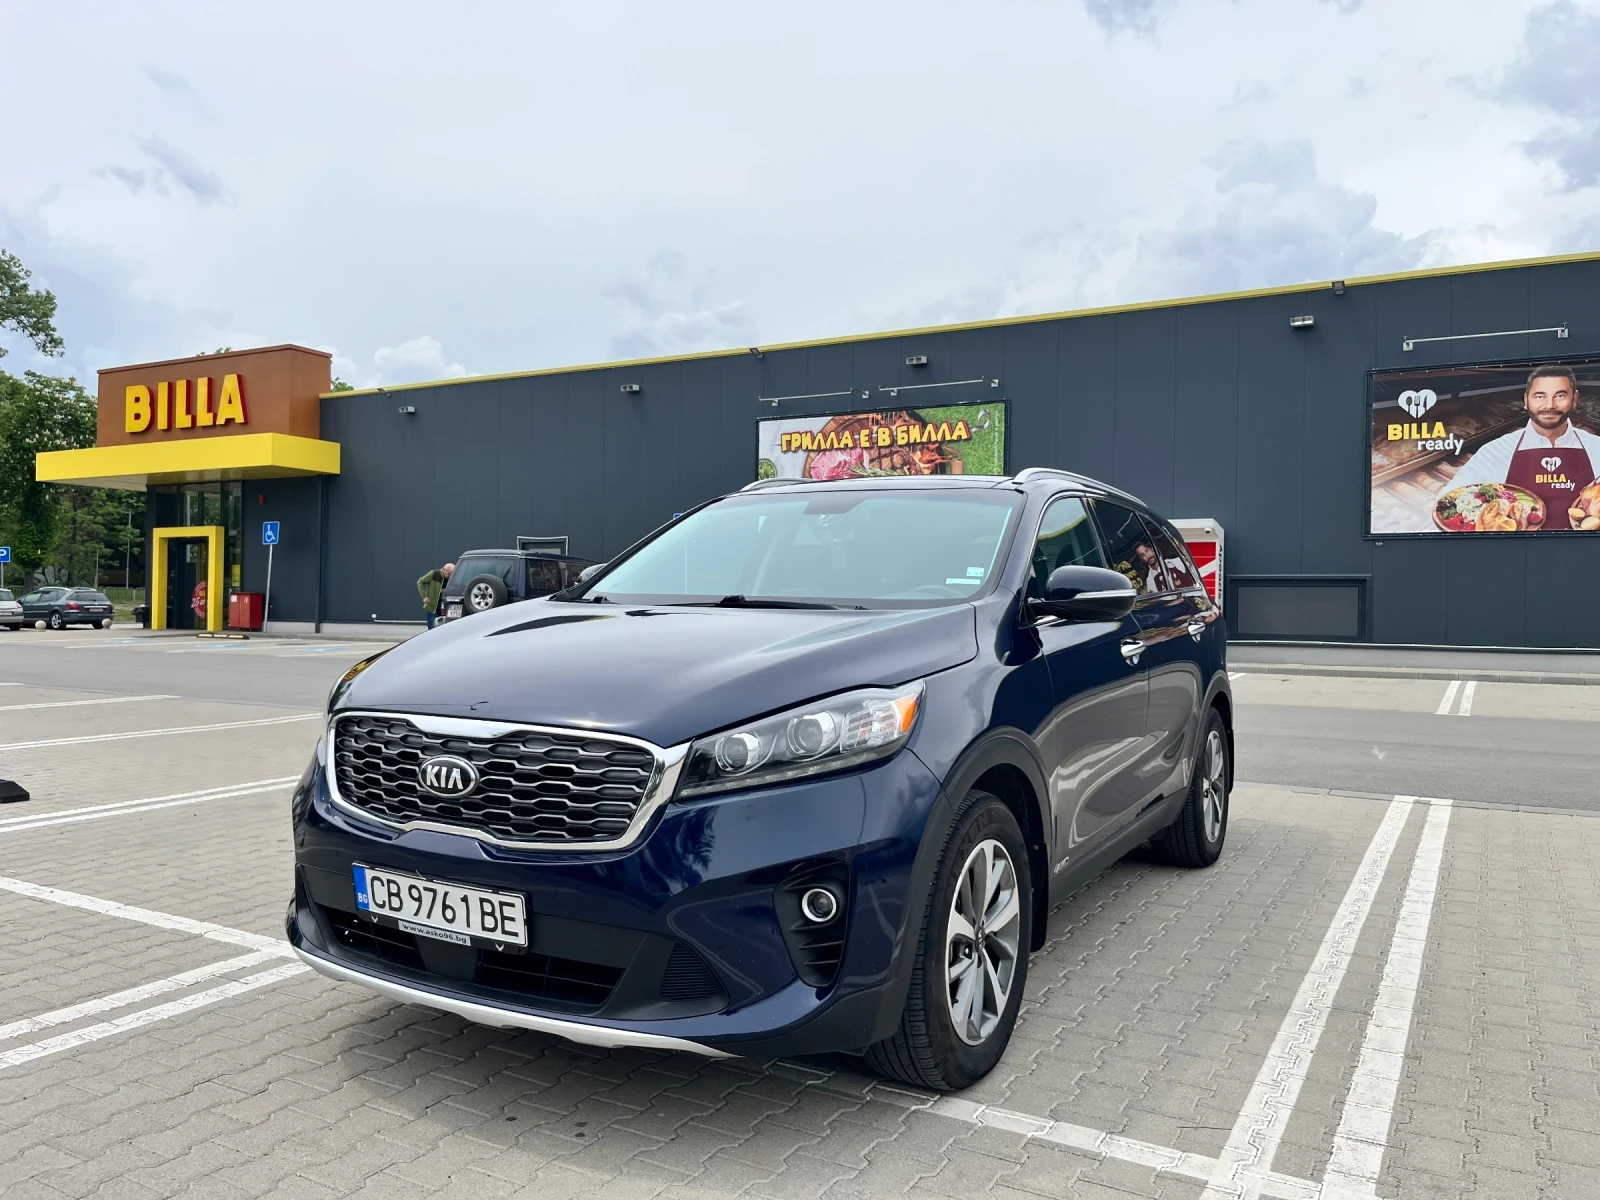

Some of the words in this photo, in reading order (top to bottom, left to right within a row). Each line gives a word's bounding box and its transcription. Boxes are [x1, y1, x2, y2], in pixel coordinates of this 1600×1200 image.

[125, 373, 248, 433] BILLA
[780, 428, 855, 452] ГРИЛЛА
[859, 428, 872, 448] Е
[877, 425, 893, 447] В
[896, 418, 971, 446] БИЛЛА
[1387, 421, 1447, 441] BILLA
[1417, 433, 1464, 456] ready
[1535, 473, 1567, 484] BILLA
[1550, 479, 1576, 491] ready
[425, 764, 464, 790] KIA
[357, 892, 368, 904] BG
[401, 923, 467, 944] www.asko96.bg
